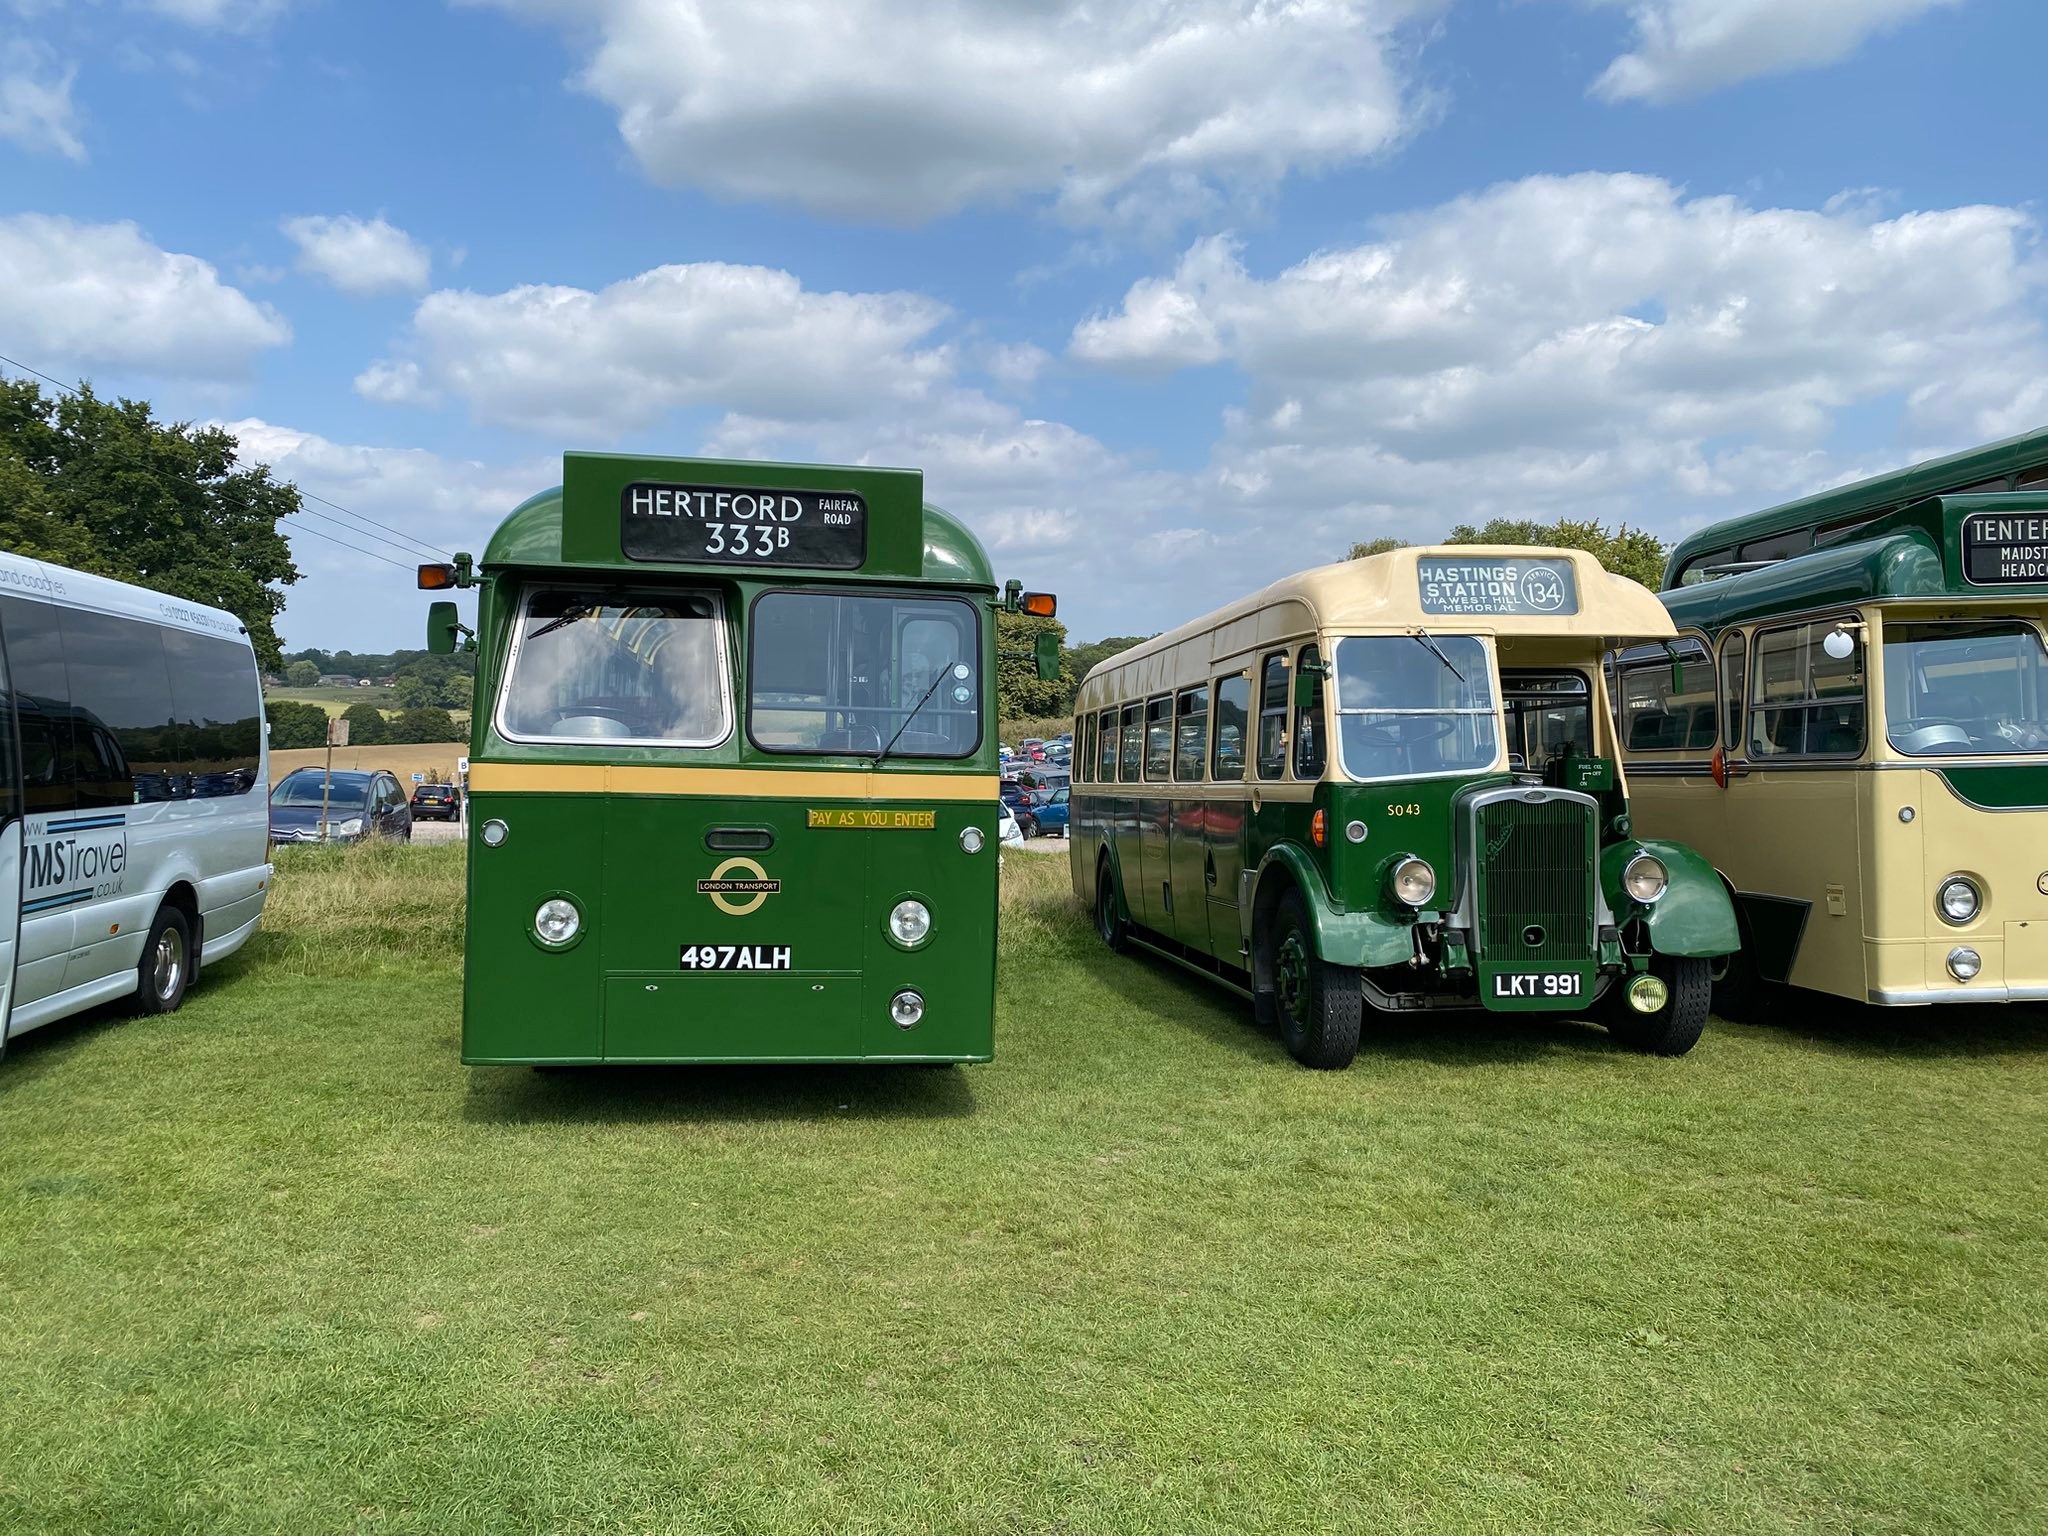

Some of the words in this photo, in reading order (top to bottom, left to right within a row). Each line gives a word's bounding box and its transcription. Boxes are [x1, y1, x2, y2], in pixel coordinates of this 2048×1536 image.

[632, 489, 803, 522] HERTFORD
[818, 499, 859, 512] FAIRFAX
[823, 513, 851, 525] ROAD
[704, 522, 790, 557] 333B
[2001, 546, 2048, 560] MAIDST
[1420, 567, 1518, 582] HASTINGS
[1528, 570, 1556, 581] SERVICE
[2001, 563, 2048, 577] HEADC
[1427, 582, 1515, 597] STATION
[1527, 582, 1561, 603] 134
[1422, 597, 1449, 605] VIA
[1451, 596, 1488, 604] WEST
[1444, 604, 1516, 612] MEMORIAL
[811, 811, 833, 825] PAY
[839, 812, 854, 825] AS
[862, 812, 887, 826] YOU
[894, 812, 932, 826] ENTER
[700, 882, 732, 890] LONDON
[735, 882, 778, 890] TRANSPORT
[681, 946, 791, 969] 497ALH
[1496, 975, 1539, 996] LKT
[1543, 974, 1580, 995] 991
